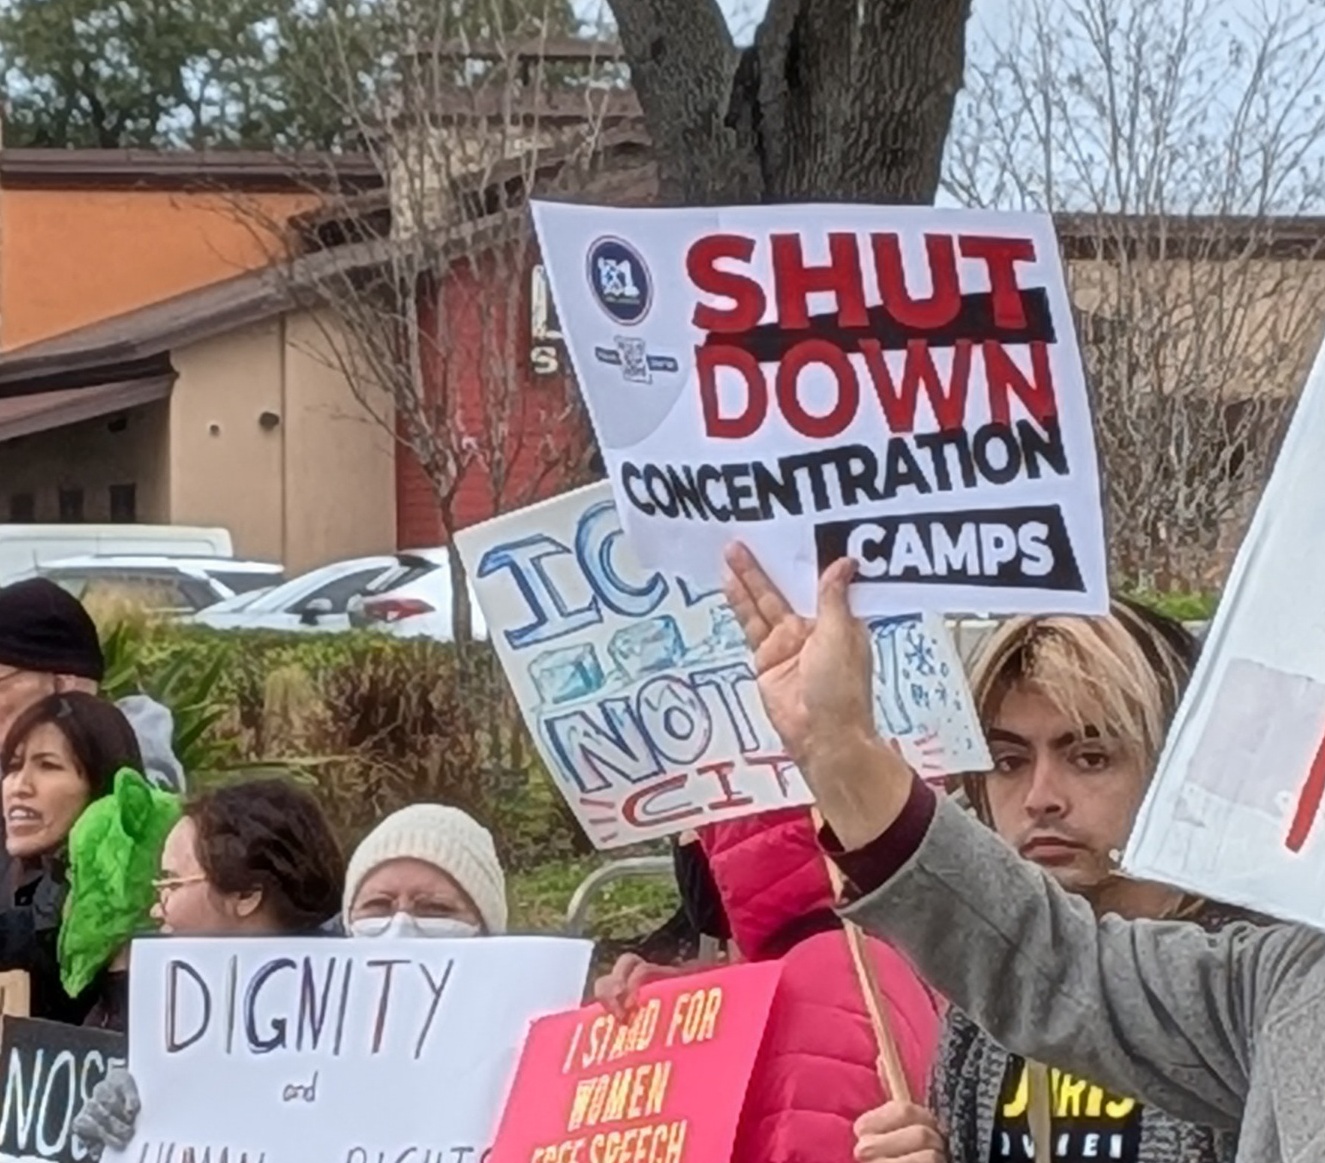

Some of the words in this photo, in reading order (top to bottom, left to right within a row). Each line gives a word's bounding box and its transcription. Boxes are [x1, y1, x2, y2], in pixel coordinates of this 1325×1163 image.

[685, 231, 1037, 334] SHUT
[694, 337, 1058, 439] DOWN
[621, 419, 1070, 523] CONCENTRATION
[477, 500, 728, 650] IC
[846, 521, 1055, 578] CAMPS
[545, 660, 762, 794] NOT
[621, 753, 798, 828] CIT
[164, 955, 454, 1060] DIGNITY
[666, 986, 723, 1049] FOR
[282, 1072, 319, 1103] and
[567, 1060, 672, 1132] WOMEN
